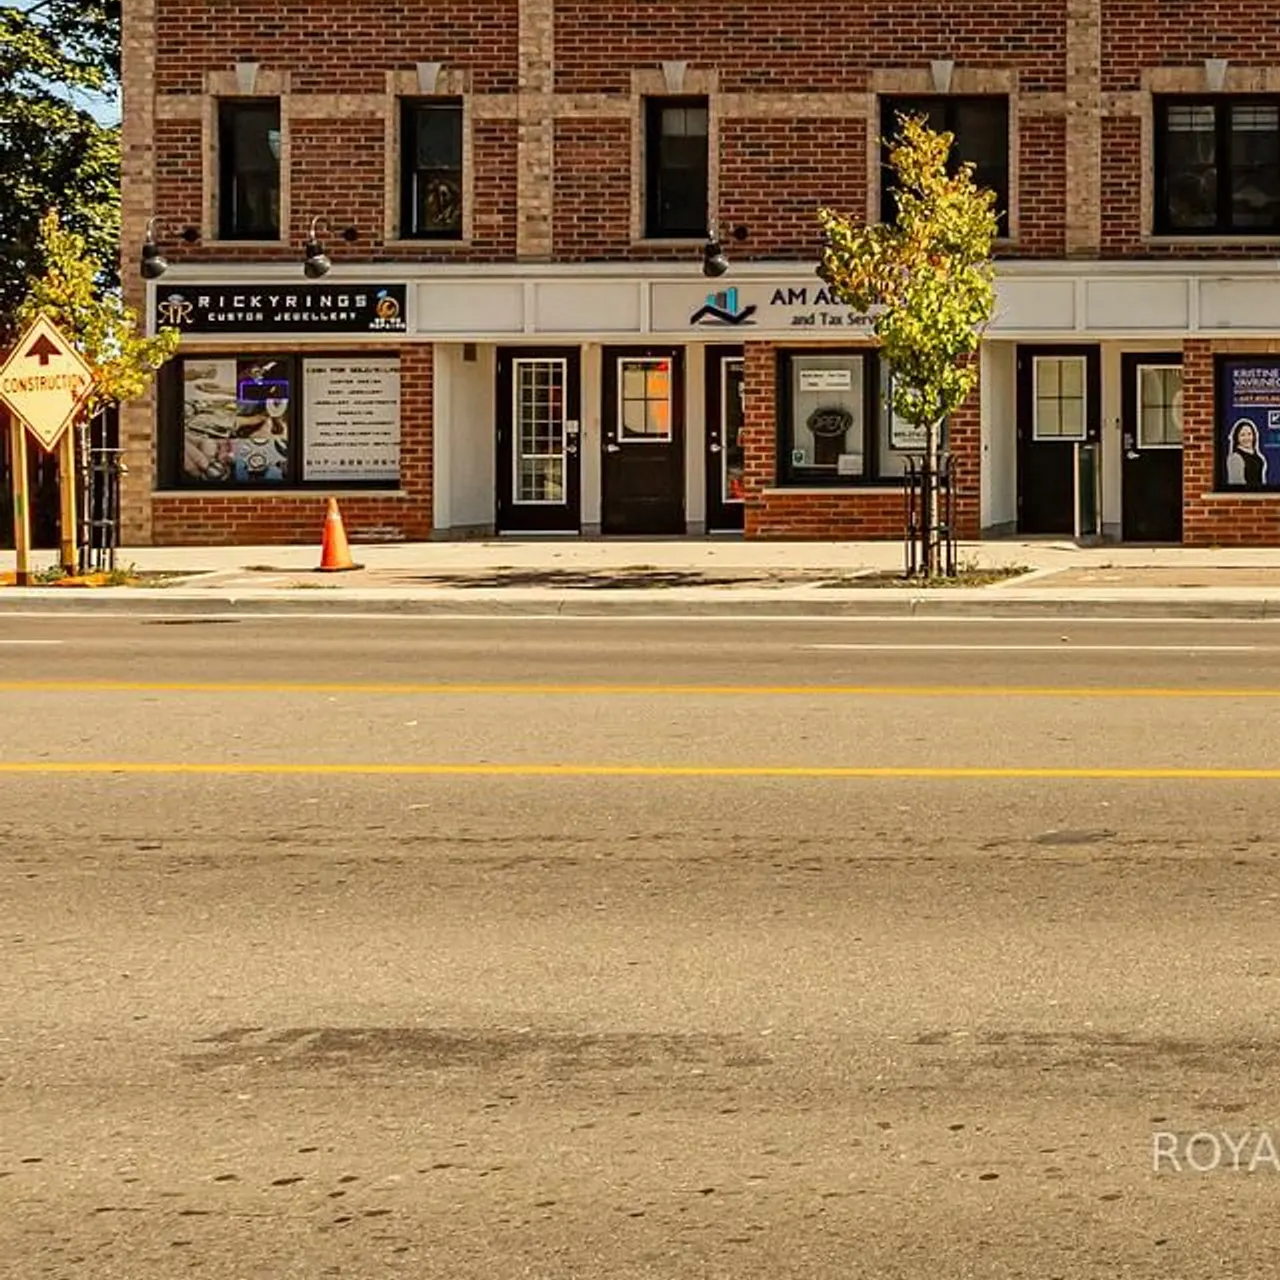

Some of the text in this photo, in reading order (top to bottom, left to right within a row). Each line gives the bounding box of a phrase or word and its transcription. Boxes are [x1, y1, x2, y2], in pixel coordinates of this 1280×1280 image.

[198, 295, 367, 308] RICKYRINGS
[770, 288, 807, 305] AM
[208, 312, 356, 322] CUSTOM JEWELLERY
[791, 312, 815, 325] and
[819, 312, 842, 325] Tax
